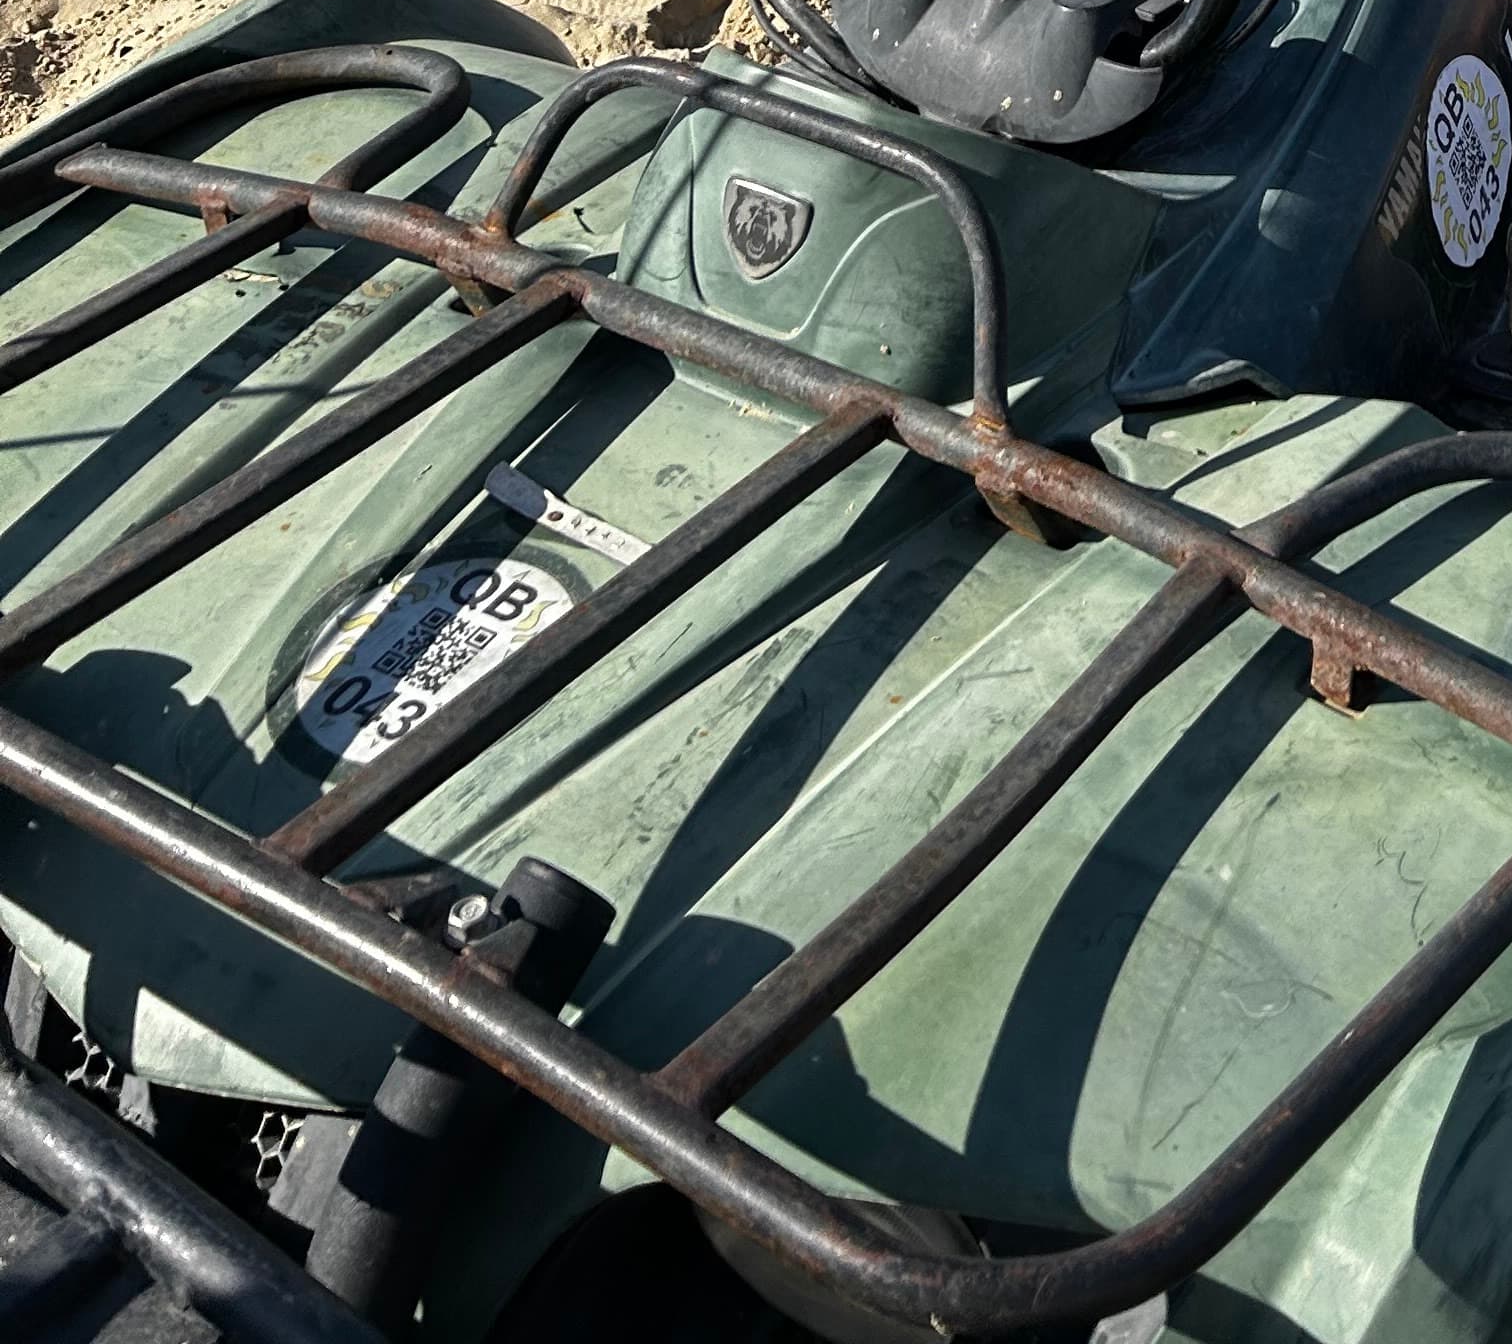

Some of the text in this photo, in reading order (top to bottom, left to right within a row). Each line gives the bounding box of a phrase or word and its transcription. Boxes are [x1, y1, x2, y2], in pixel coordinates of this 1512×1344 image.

[1434, 82, 1464, 154] QB
[1377, 114, 1425, 241] YAMA
[1468, 164, 1500, 244] 043
[450, 568, 538, 621] QB
[323, 675, 428, 740] 043
